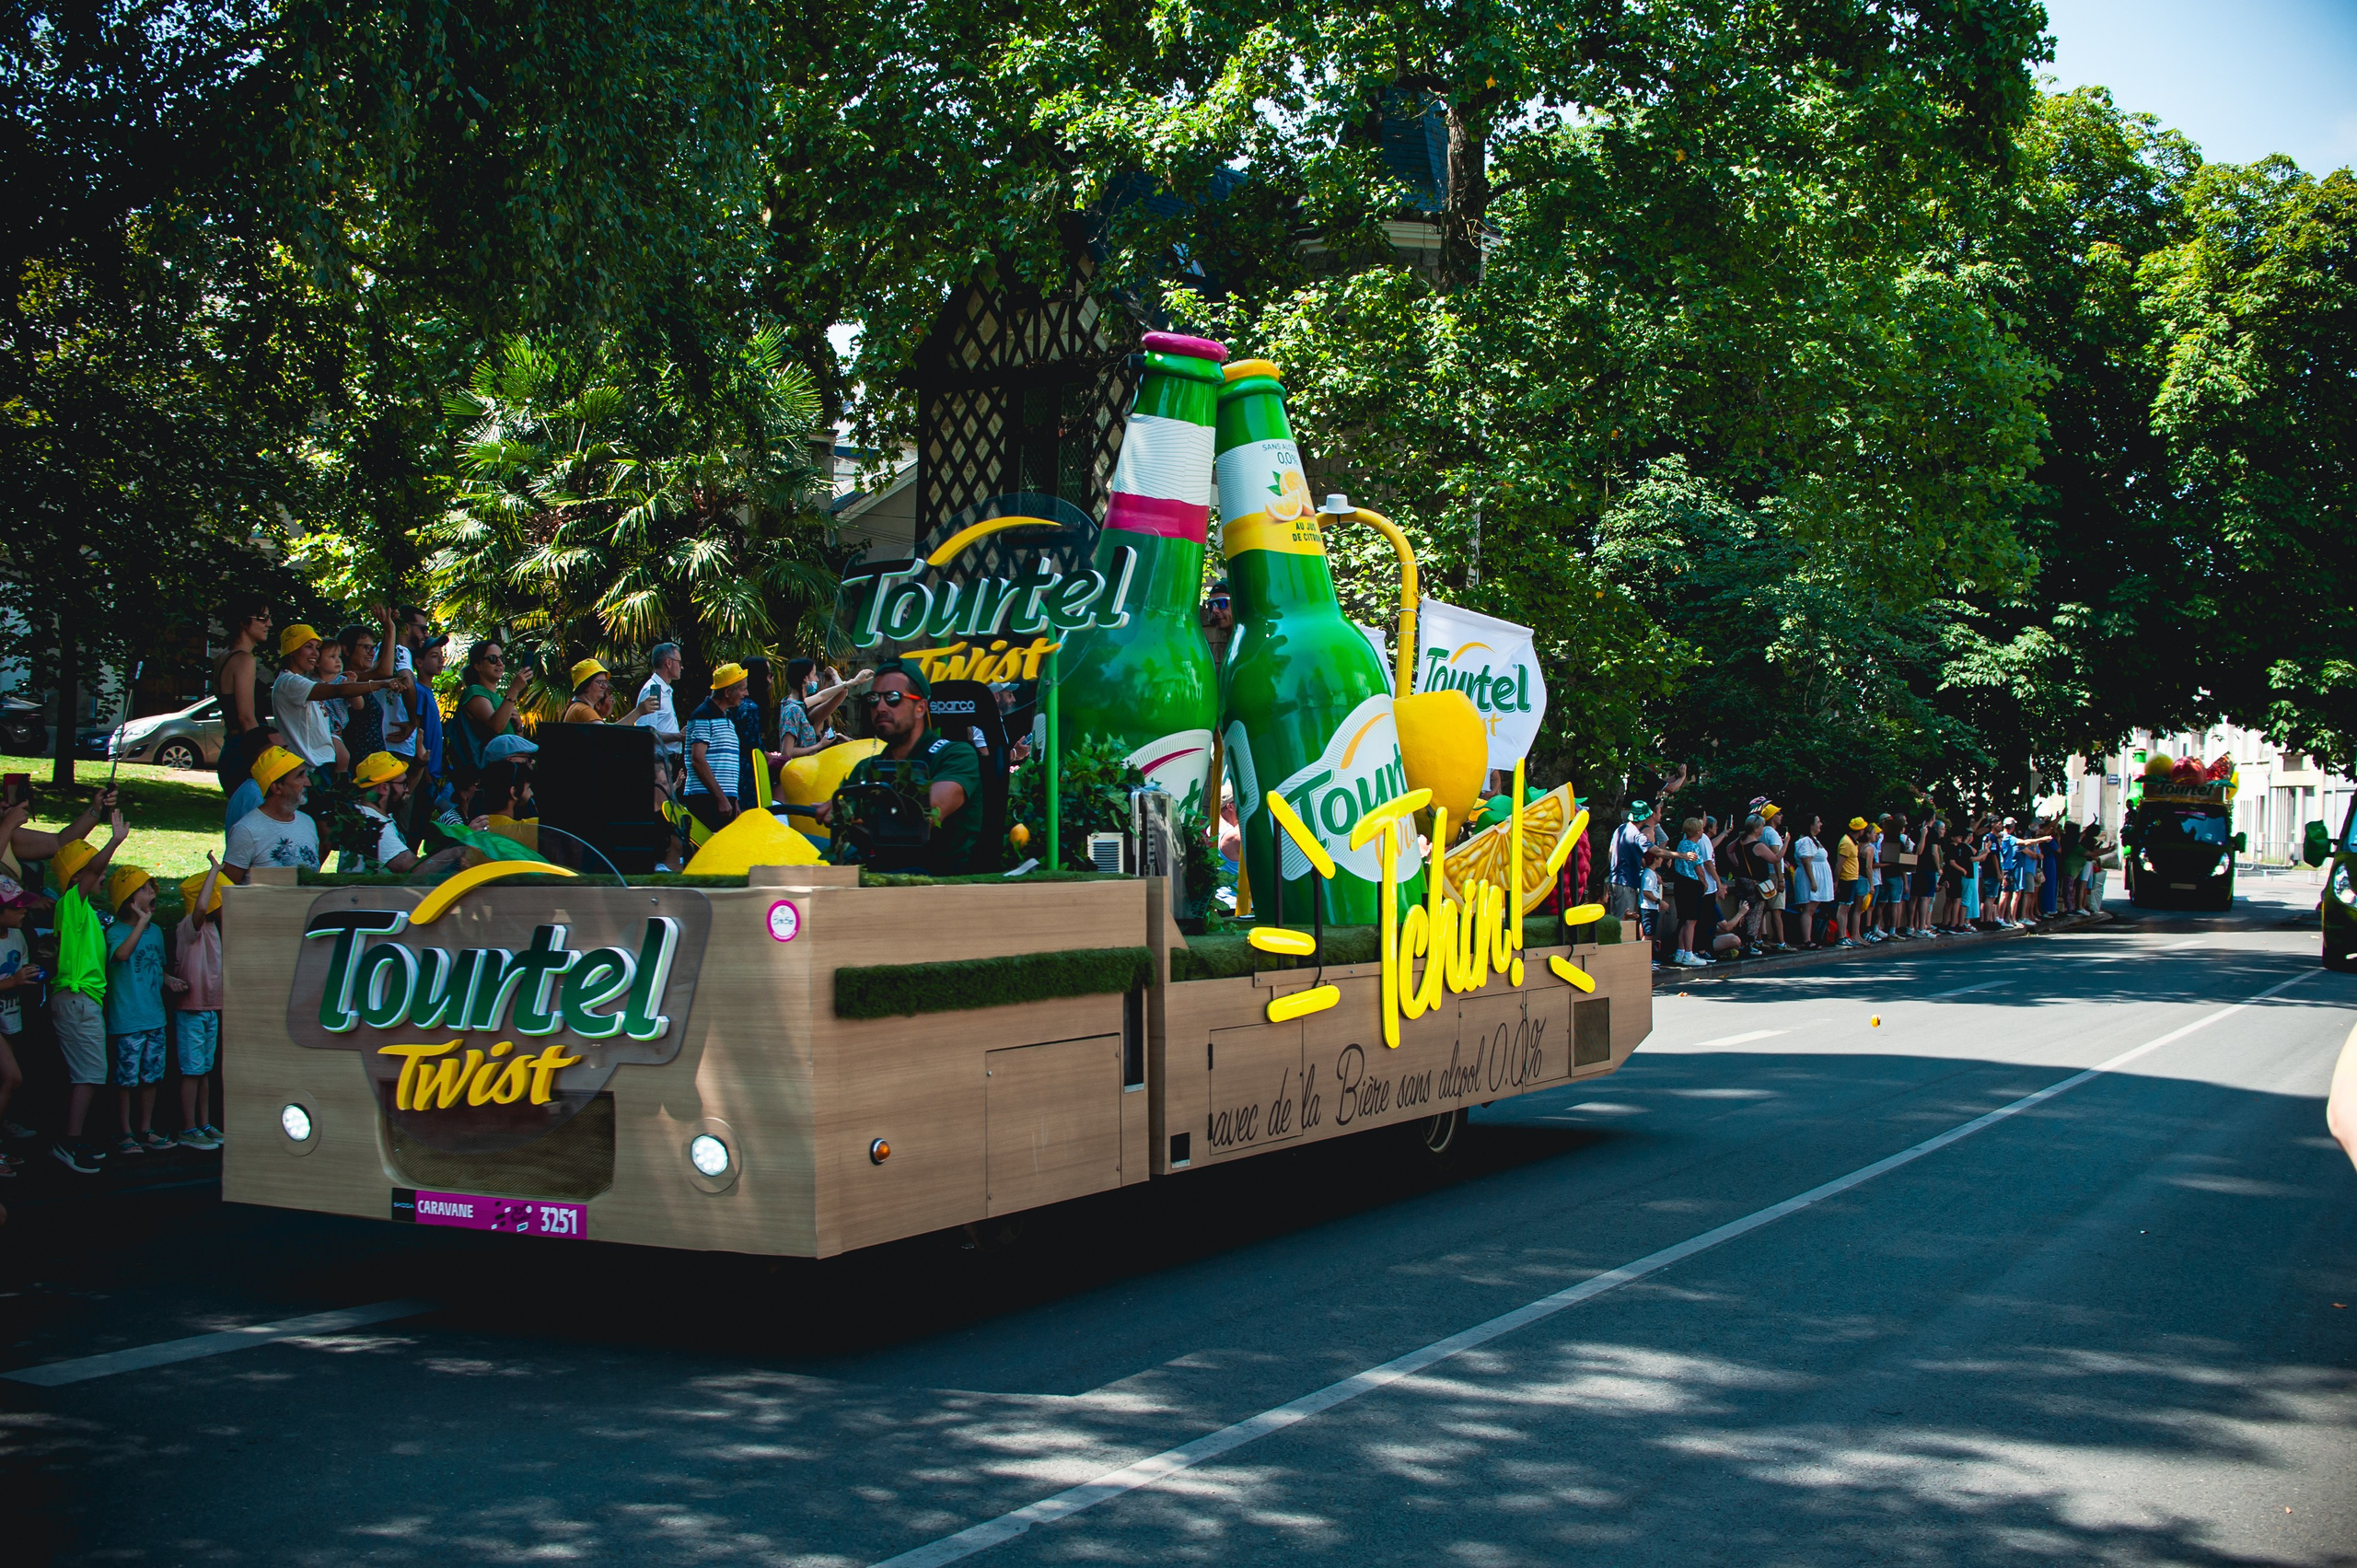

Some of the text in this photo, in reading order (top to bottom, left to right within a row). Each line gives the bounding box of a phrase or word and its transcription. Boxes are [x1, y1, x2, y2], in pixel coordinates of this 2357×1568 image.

[1262, 443, 1281, 451] SANS
[1292, 533, 1302, 542] DE
[1295, 521, 1317, 531] AU JUS
[842, 545, 1137, 648] Tourtel
[900, 637, 1062, 686] Twist
[930, 700, 976, 714] sparco
[1350, 756, 1526, 1050] Tchin!
[305, 909, 680, 1041] Tourtel
[377, 1039, 583, 1112] Twist
[1213, 1016, 1547, 1147] avec de la Bière sans alcool 0.0%
[417, 1200, 474, 1219] CARAVANE
[540, 1206, 578, 1235] 3251
